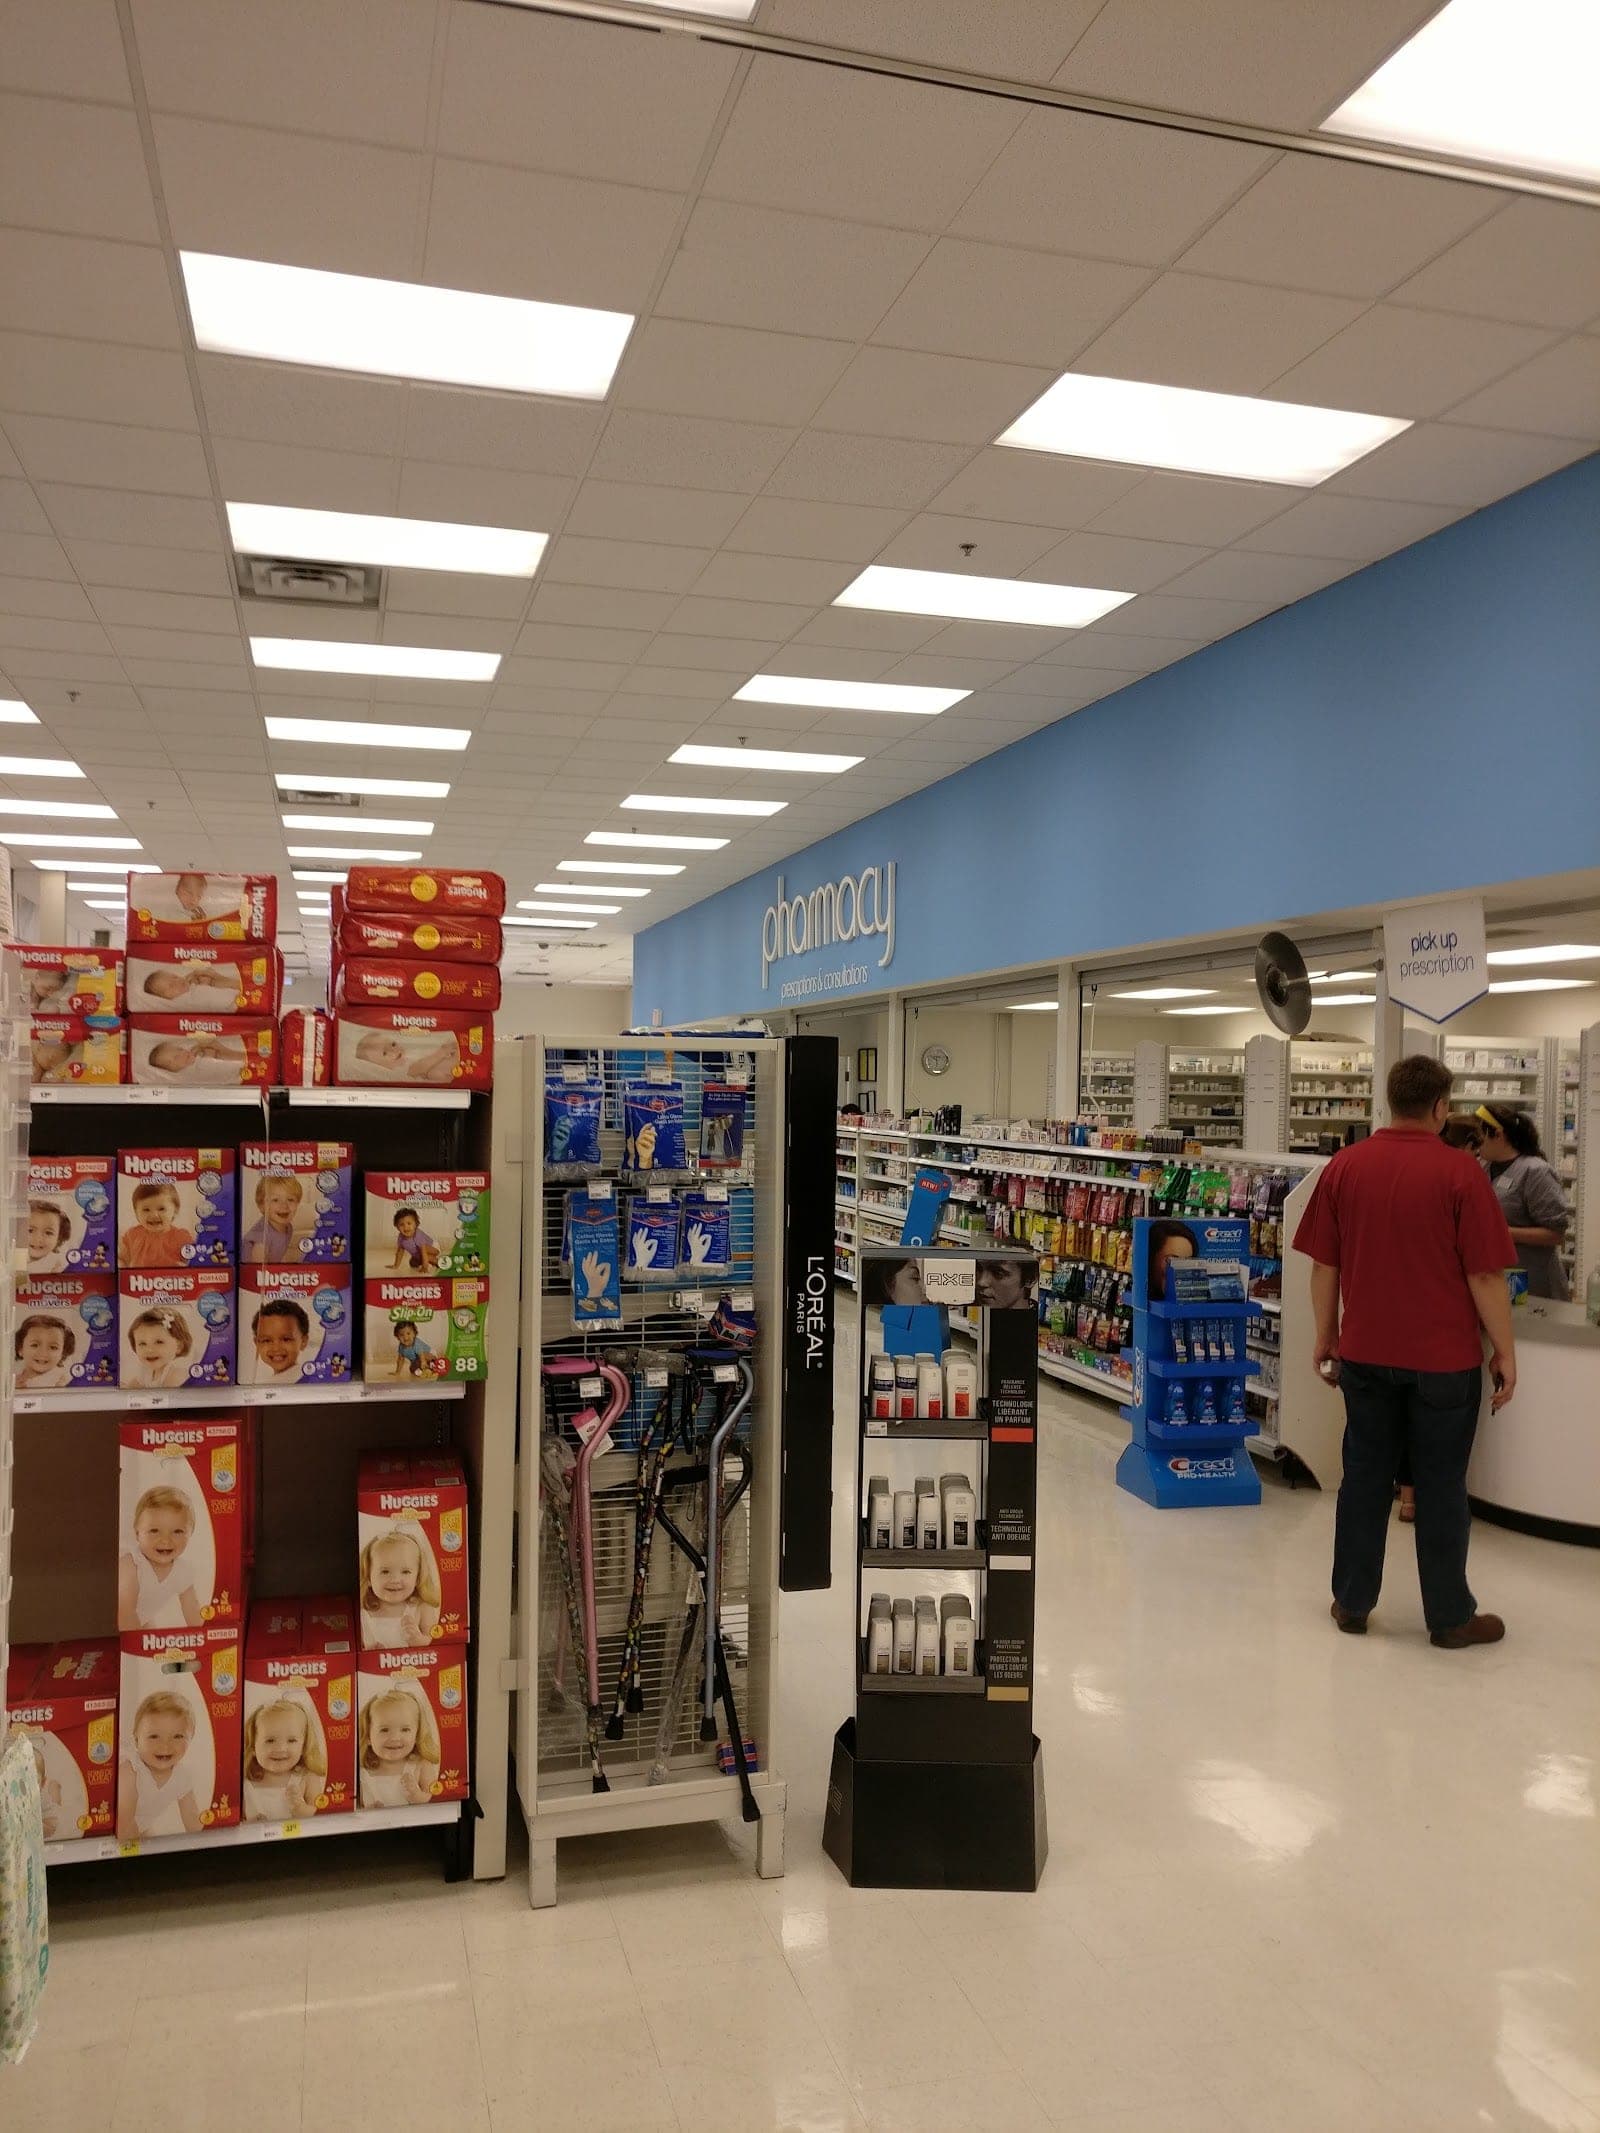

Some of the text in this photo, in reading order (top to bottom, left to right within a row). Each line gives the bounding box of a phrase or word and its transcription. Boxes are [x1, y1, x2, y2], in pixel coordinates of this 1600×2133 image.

[447, 886, 489, 900] HUGGIES
[252, 886, 267, 939] HUGGIES
[362, 926, 403, 939] HUGGIES
[762, 861, 897, 989] pharmacy
[1411, 931, 1457, 956] pick up
[174, 947, 218, 960] HUGGIES
[1400, 953, 1474, 981] prescription
[362, 975, 404, 987] HUGGIES
[179, 1019, 223, 1032] HUGGIES
[392, 1014, 437, 1028] HUGGIES
[246, 1148, 314, 1166] HUGGIES
[30, 1165, 73, 1179] GGIES
[125, 1156, 195, 1174] HUGGIES
[29, 1184, 60, 1193] overs
[388, 1177, 451, 1194] HUGGIES
[1205, 1227, 1242, 1239] Crest
[130, 1275, 194, 1292] HUGGIES
[257, 1270, 320, 1287] HUGGIES
[926, 1272, 974, 1287] AXE
[381, 1282, 442, 1300] HUGGIES
[29, 1299, 71, 1308] movers
[140, 1295, 182, 1305] movers
[796, 1292, 804, 1334] PARIS
[806, 1256, 827, 1369] L'ORÉAL
[438, 1357, 478, 1372] 3 88
[992, 1400, 1034, 1409] TECHNOLOGIE
[1004, 1416, 1031, 1424] PARFUM
[143, 1429, 205, 1445] HUGGIES
[1169, 1456, 1234, 1472] Crest
[380, 1494, 439, 1510] HUGGIES
[991, 1525, 1031, 1534] TECHNOLOGIE
[992, 1533, 1031, 1541] ANTI ODEURS
[143, 1635, 205, 1650] HUGGIES
[380, 1653, 438, 1668] HUGGIES
[268, 1662, 327, 1677] HUGGIES
[7, 1707, 54, 1722] GGIES
